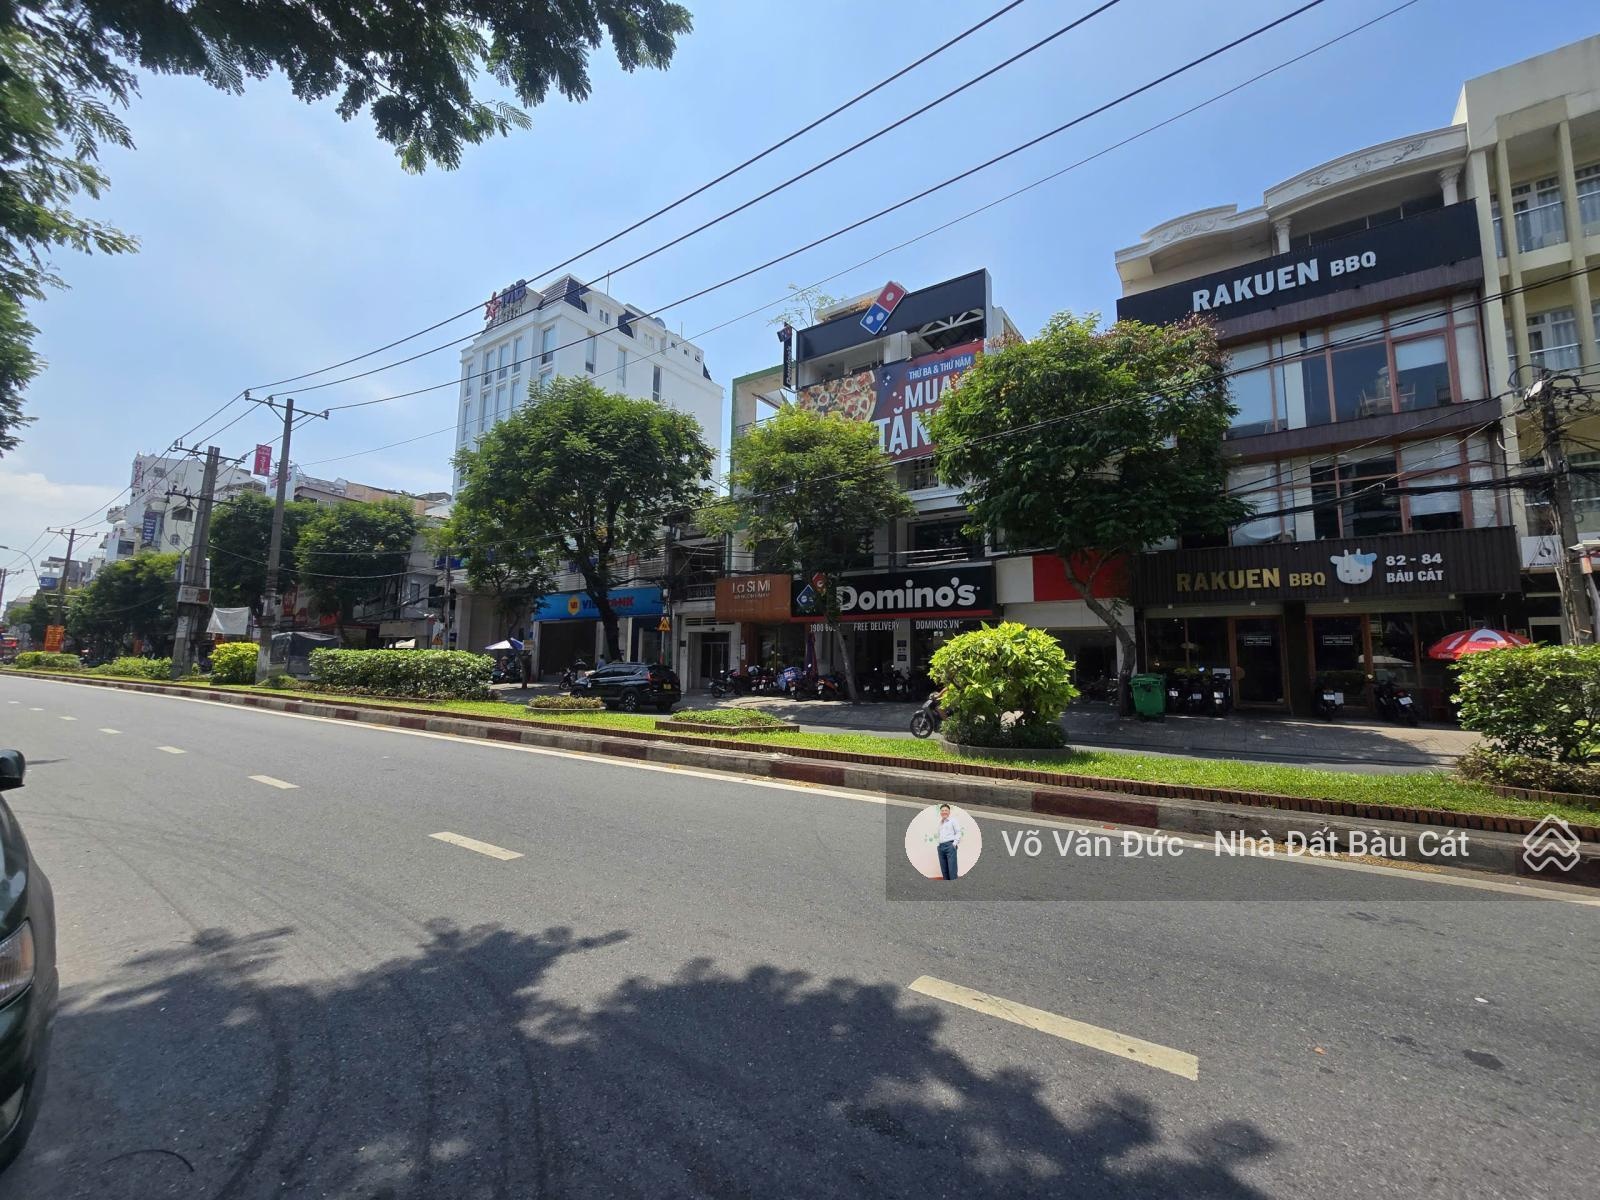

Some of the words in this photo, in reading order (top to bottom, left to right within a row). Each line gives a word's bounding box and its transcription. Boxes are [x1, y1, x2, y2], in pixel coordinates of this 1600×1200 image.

[1193, 258, 1320, 312] RAKUEN
[1330, 251, 1377, 277] BBQ
[909, 367, 922, 380] THỨ
[923, 368, 932, 377] BA
[933, 364, 939, 374] &
[940, 359, 954, 372] THỨ
[954, 355, 972, 369] NĂM
[905, 375, 953, 409] MUA
[872, 406, 945, 455] TẶN
[1386, 555, 1407, 566] 82
[1421, 553, 1443, 565] 84
[1176, 567, 1281, 592] RAKUEN
[1289, 571, 1326, 587] BBQ
[1417, 567, 1444, 582] CÁT
[582, 597, 634, 609] VIANK
[836, 577, 976, 611] Domino's
[810, 624, 824, 632] 1900
[853, 622, 869, 631] FREE
[870, 621, 900, 631] DELIVERY
[915, 620, 960, 630] DOMINOS.VN
